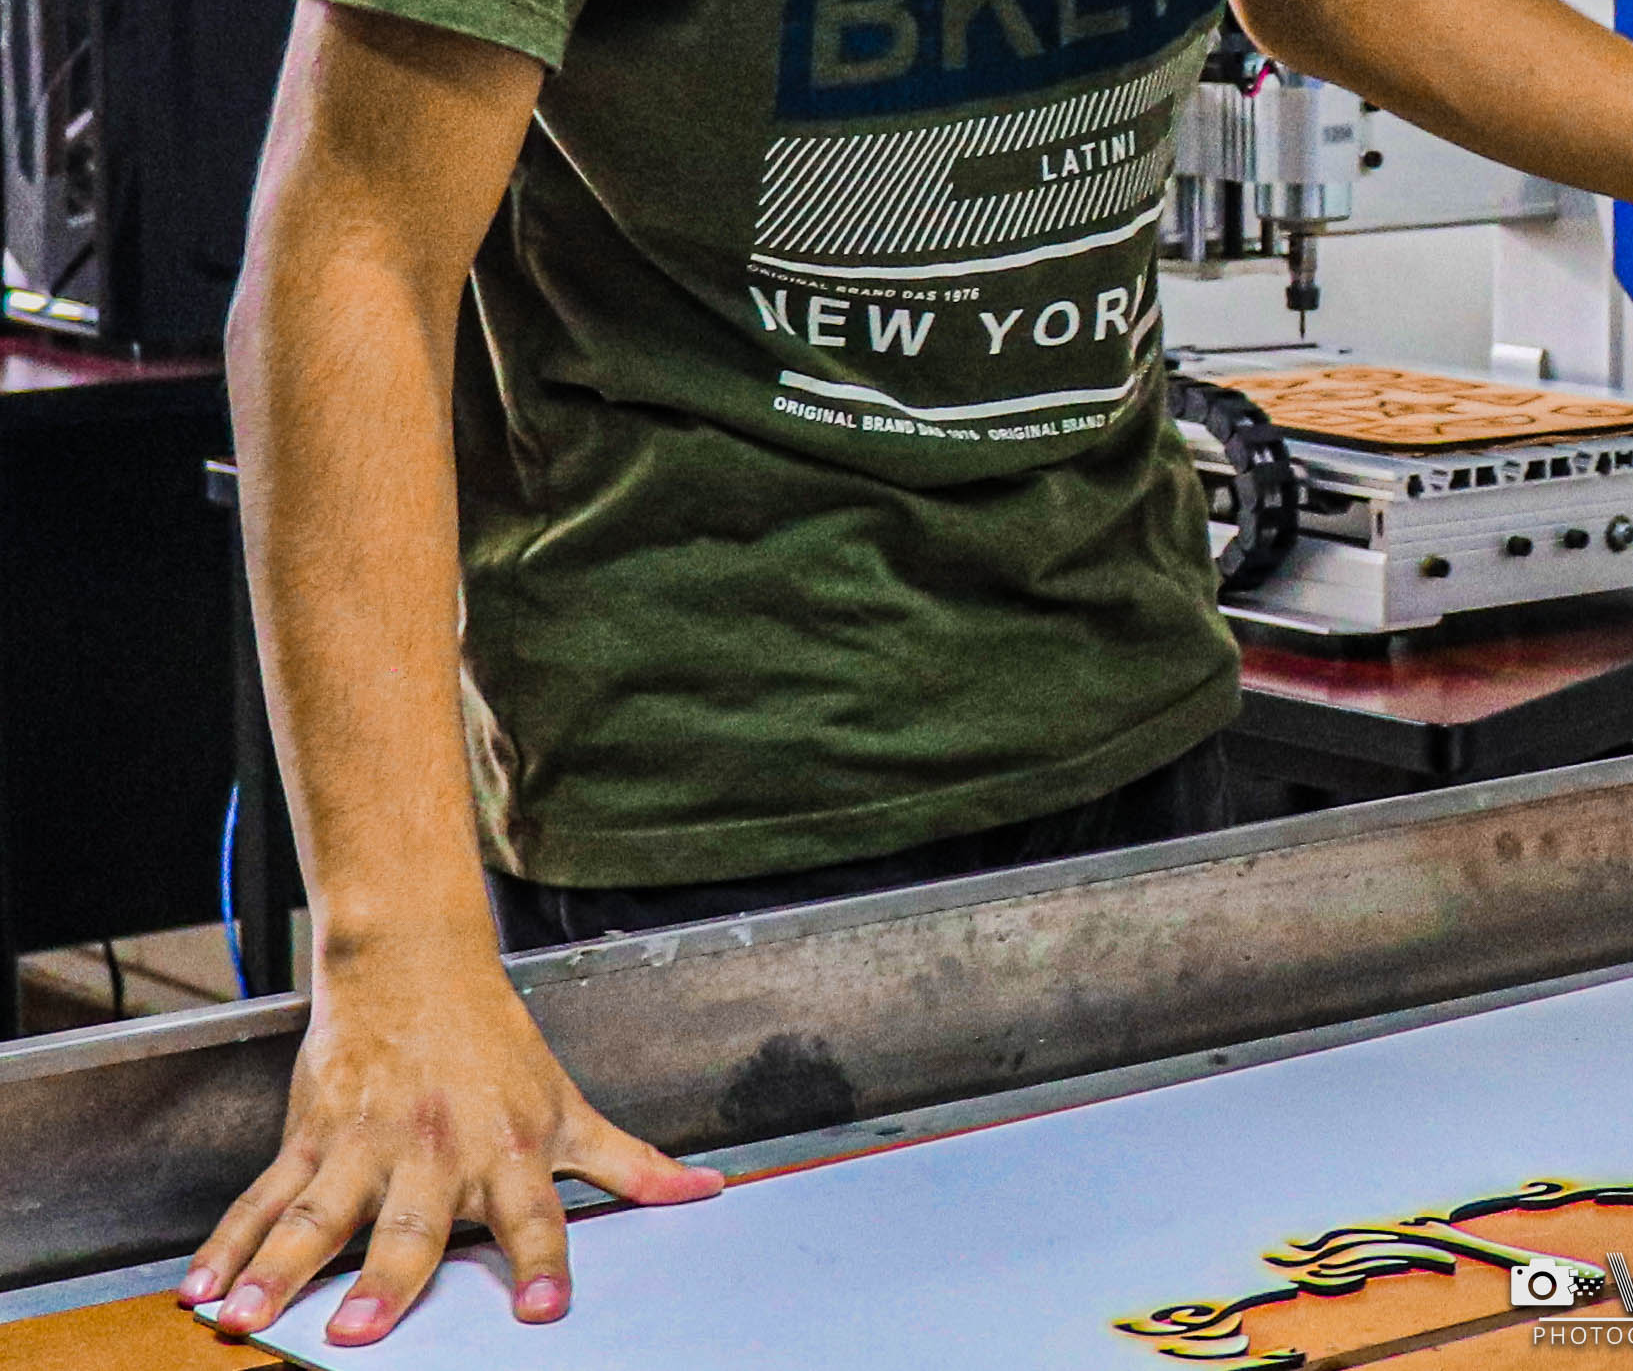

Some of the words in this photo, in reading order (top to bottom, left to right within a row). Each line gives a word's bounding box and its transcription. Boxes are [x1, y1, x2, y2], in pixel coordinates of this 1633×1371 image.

[747, 264, 829, 291] ORIGINAL
[835, 285, 897, 299] BRAND
[902, 290, 938, 302] DAS
[944, 287, 981, 303] 1976
[749, 285, 936, 357] NEW
[773, 396, 857, 429] ORIGINAL
[862, 415, 915, 434] BRAND
[987, 422, 1060, 441] ORIGINAL
[1062, 413, 1106, 434] BRAND
